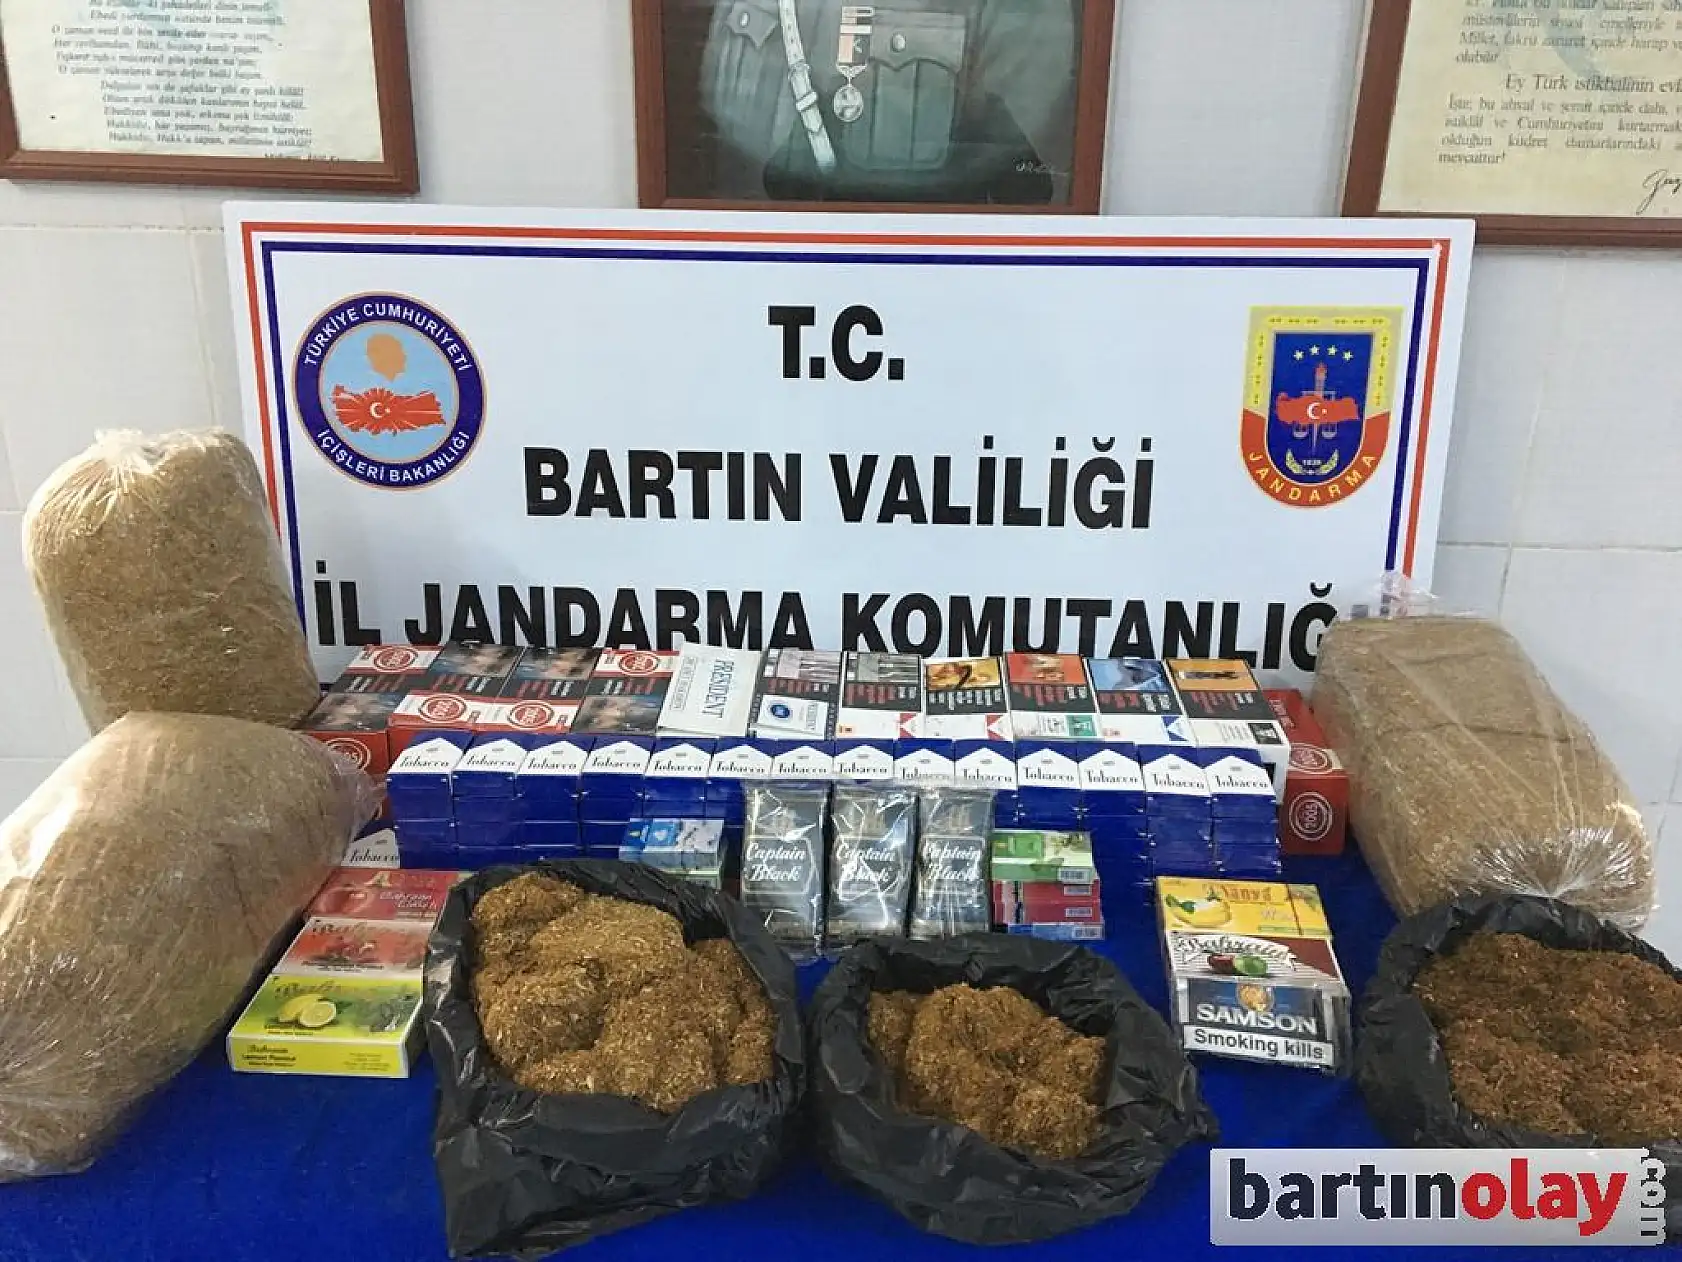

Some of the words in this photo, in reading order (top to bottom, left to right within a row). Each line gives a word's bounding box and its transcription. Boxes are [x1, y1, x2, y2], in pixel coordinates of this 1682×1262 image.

[304, 306, 360, 366] TÜRKİYE
[363, 303, 473, 371] CUMHURİYETİ
[768, 305, 905, 381] T.C.
[317, 429, 385, 481] İÇİŞLERİ
[389, 431, 470, 482] BAKANLIĞI
[524, 447, 802, 521] BARTIN
[829, 435, 1154, 529] VALİLİĞİ
[1249, 451, 1377, 502] JANDARMA
[314, 560, 381, 647] İL
[404, 582, 815, 652] JANDARMA
[841, 582, 1338, 672] KOMUTANLIĞ
[527, 755, 577, 771] Tobacco
[590, 755, 641, 770] Tobacco
[654, 760, 703, 773] Tobacco
[716, 760, 765, 774] Tobacco
[1023, 766, 1075, 782] Tobacco
[1087, 767, 1139, 784] Tobacco
[1152, 772, 1205, 790] Tobacco
[1215, 774, 1269, 790] Tobacco
[746, 842, 806, 866] Captain
[749, 865, 802, 882] Black
[1196, 1003, 1318, 1035] SAMSON
[1194, 1028, 1279, 1058] Smoking
[1285, 1039, 1324, 1060] kills
